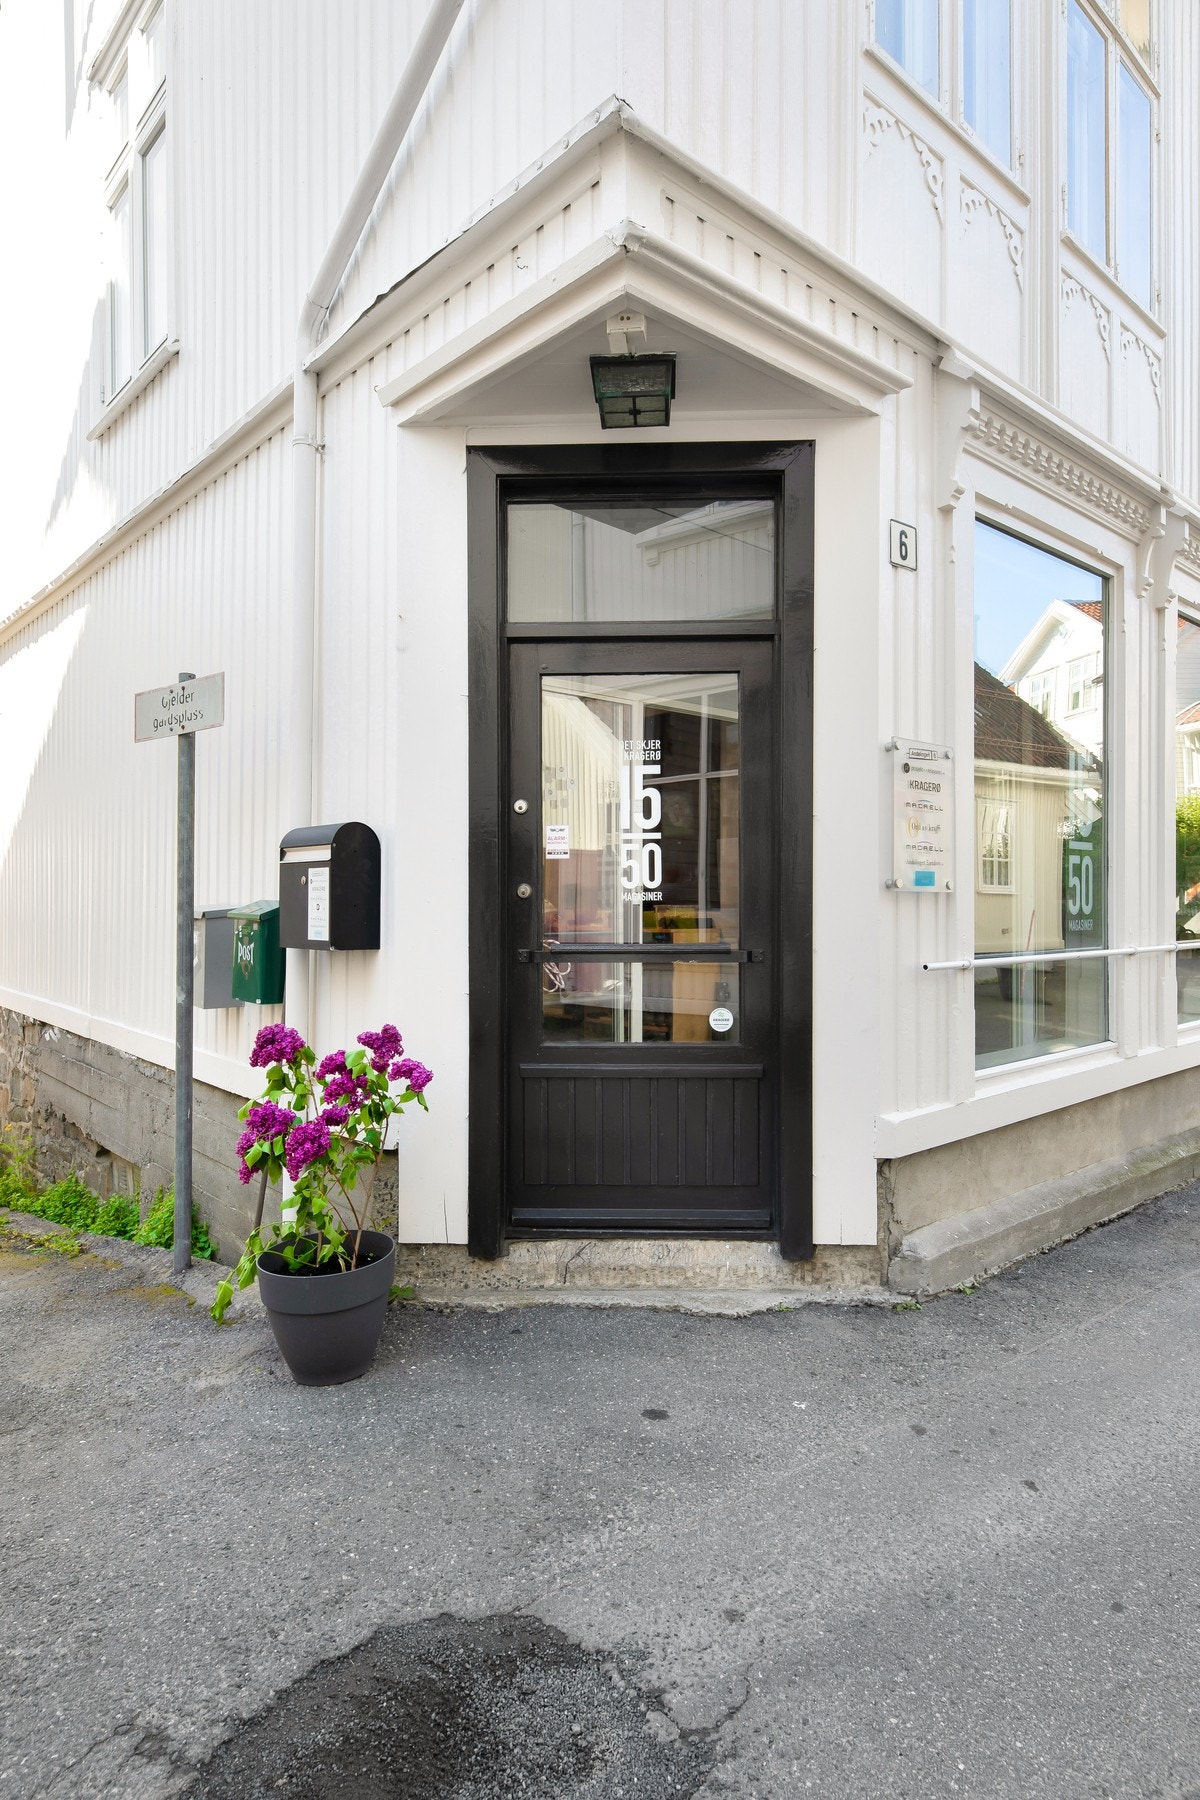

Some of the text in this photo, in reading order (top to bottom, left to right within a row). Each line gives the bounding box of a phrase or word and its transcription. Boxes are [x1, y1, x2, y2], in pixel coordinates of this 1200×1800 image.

[900, 530, 907, 560] 6
[161, 690, 195, 711] Gjelder
[624, 750, 661, 761] KRAGERØ
[636, 740, 661, 750] SKJER
[620, 764, 662, 830] 15
[620, 842, 662, 889] 50
[621, 891, 662, 901] MAGASINER
[1068, 855, 1094, 915] 50
[238, 941, 254, 965] POST
